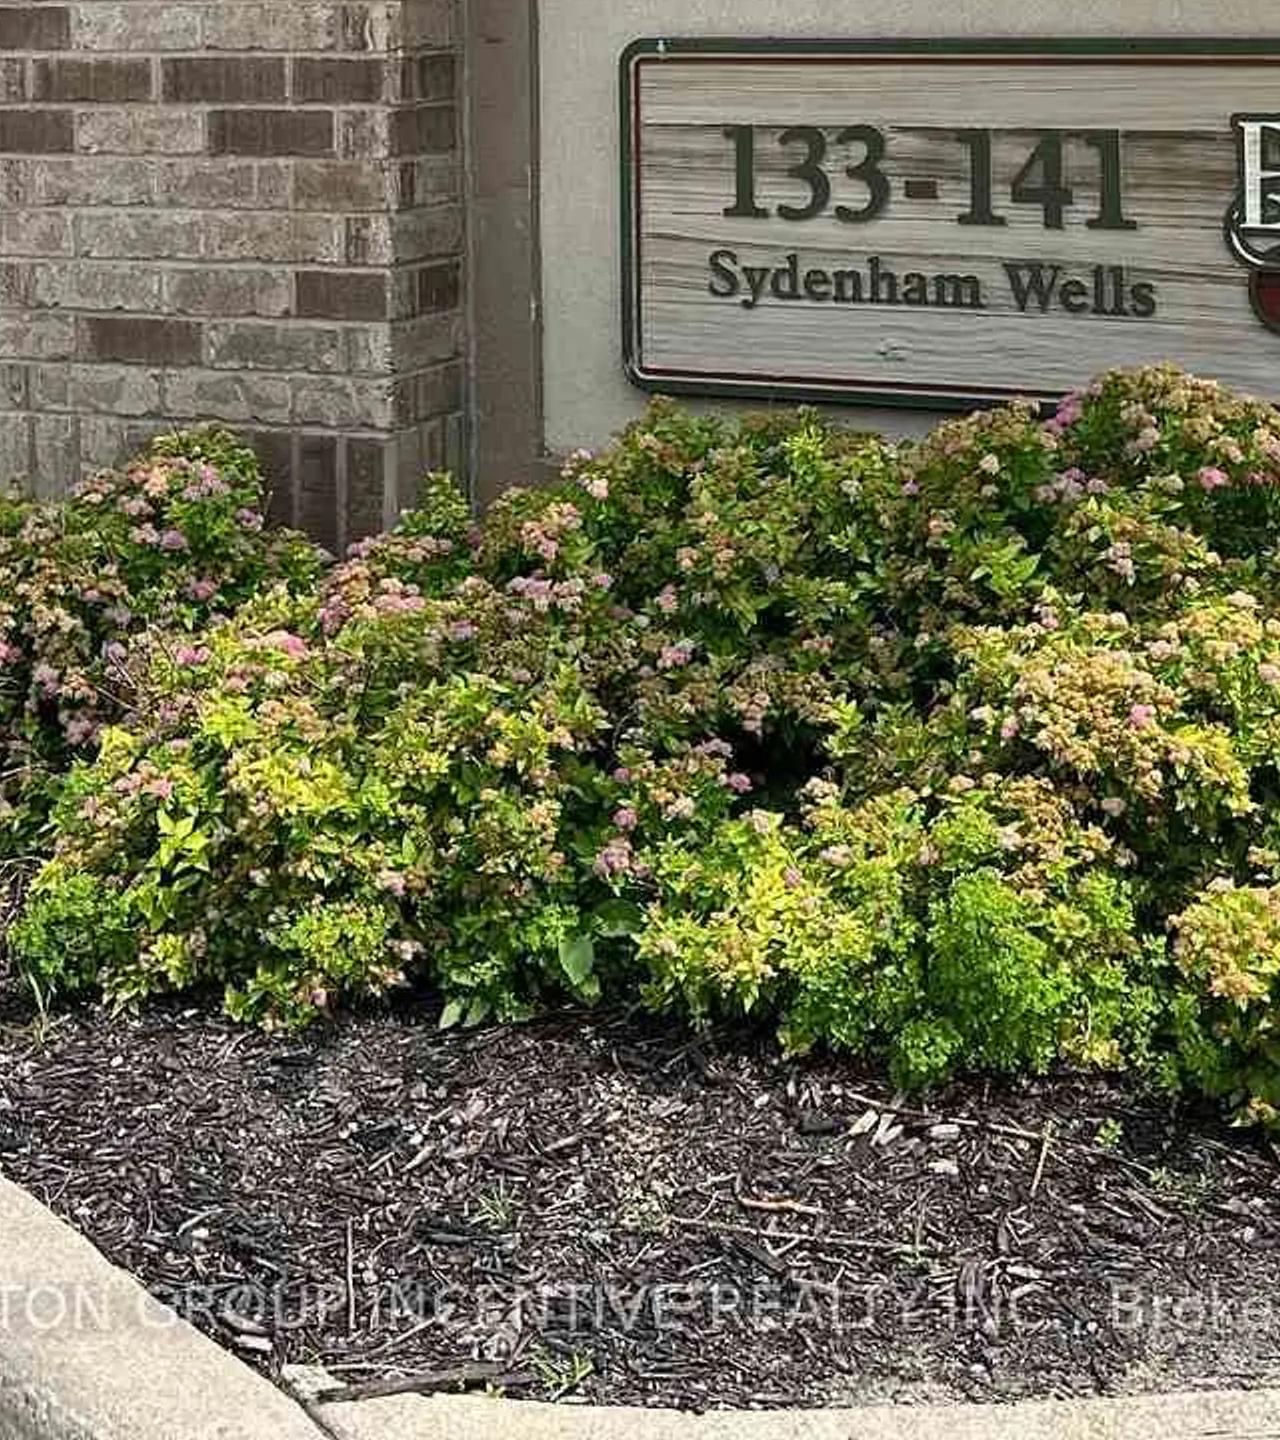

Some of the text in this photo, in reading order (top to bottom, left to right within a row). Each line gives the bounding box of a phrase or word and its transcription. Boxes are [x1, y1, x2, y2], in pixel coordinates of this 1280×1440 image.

[722, 124, 1138, 230] 133-141
[708, 250, 1157, 318] Sydenham Wells
